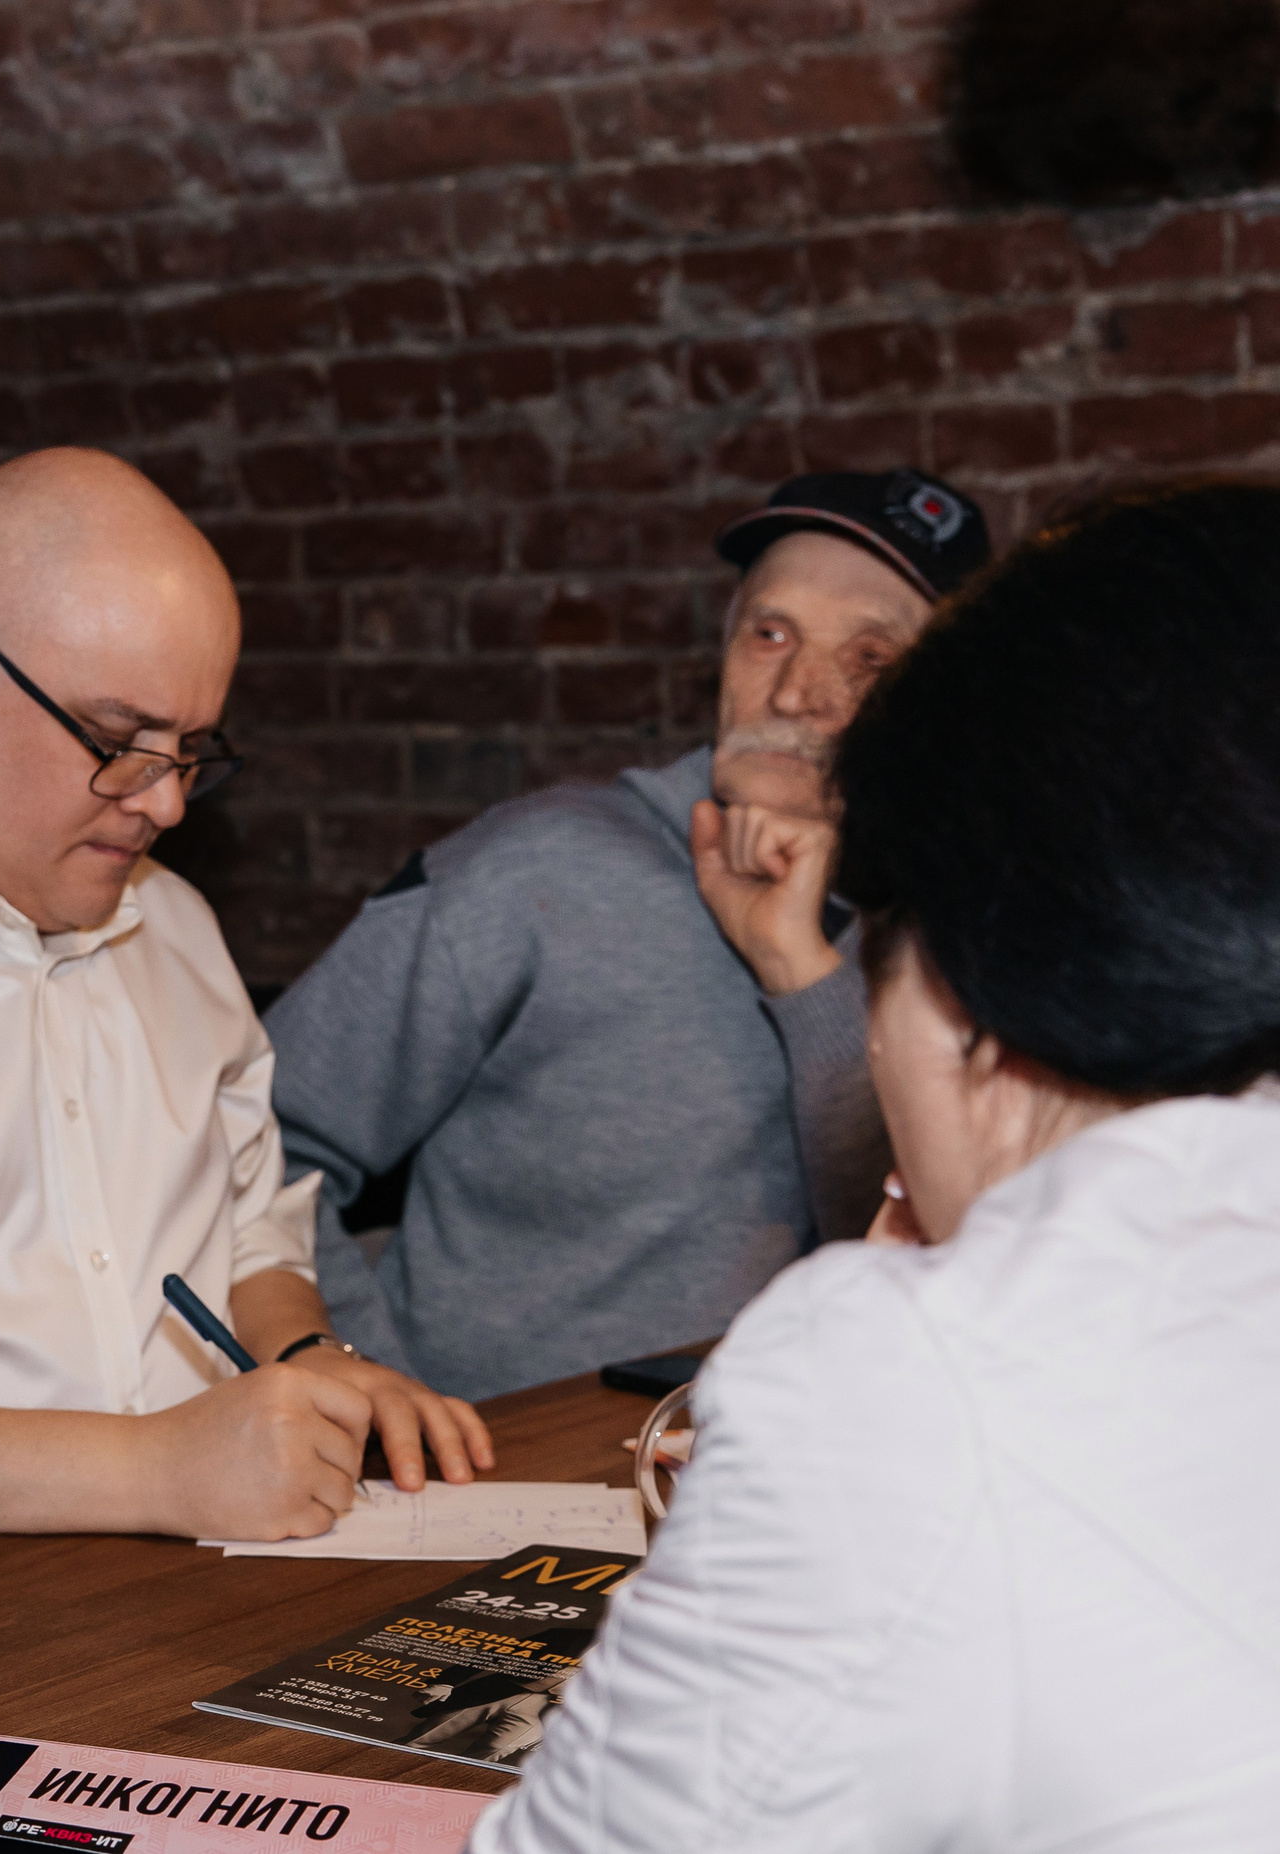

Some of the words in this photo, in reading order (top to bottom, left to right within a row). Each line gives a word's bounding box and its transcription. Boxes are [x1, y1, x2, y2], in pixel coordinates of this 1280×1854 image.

[451, 1590, 588, 1620] 24-25
[383, 1624, 533, 1659] СВОЙСТВА
[539, 1653, 583, 1668] ПИ
[396, 1616, 548, 1649] ПОЛЕЗНЫЕ
[314, 1658, 428, 1690] ХМЕЛЬ
[329, 1650, 419, 1673] ДЫМ
[419, 1667, 443, 1679] &
[301, 1684, 339, 1698] Мира,
[329, 1685, 352, 1694] 518
[351, 1690, 371, 1698] 57
[278, 1696, 363, 1719] Карасунская,
[27, 1766, 351, 1841] ИНКОГНИТО
[16, 1822, 123, 1848] РЕ-КВИЗ-ИТ
